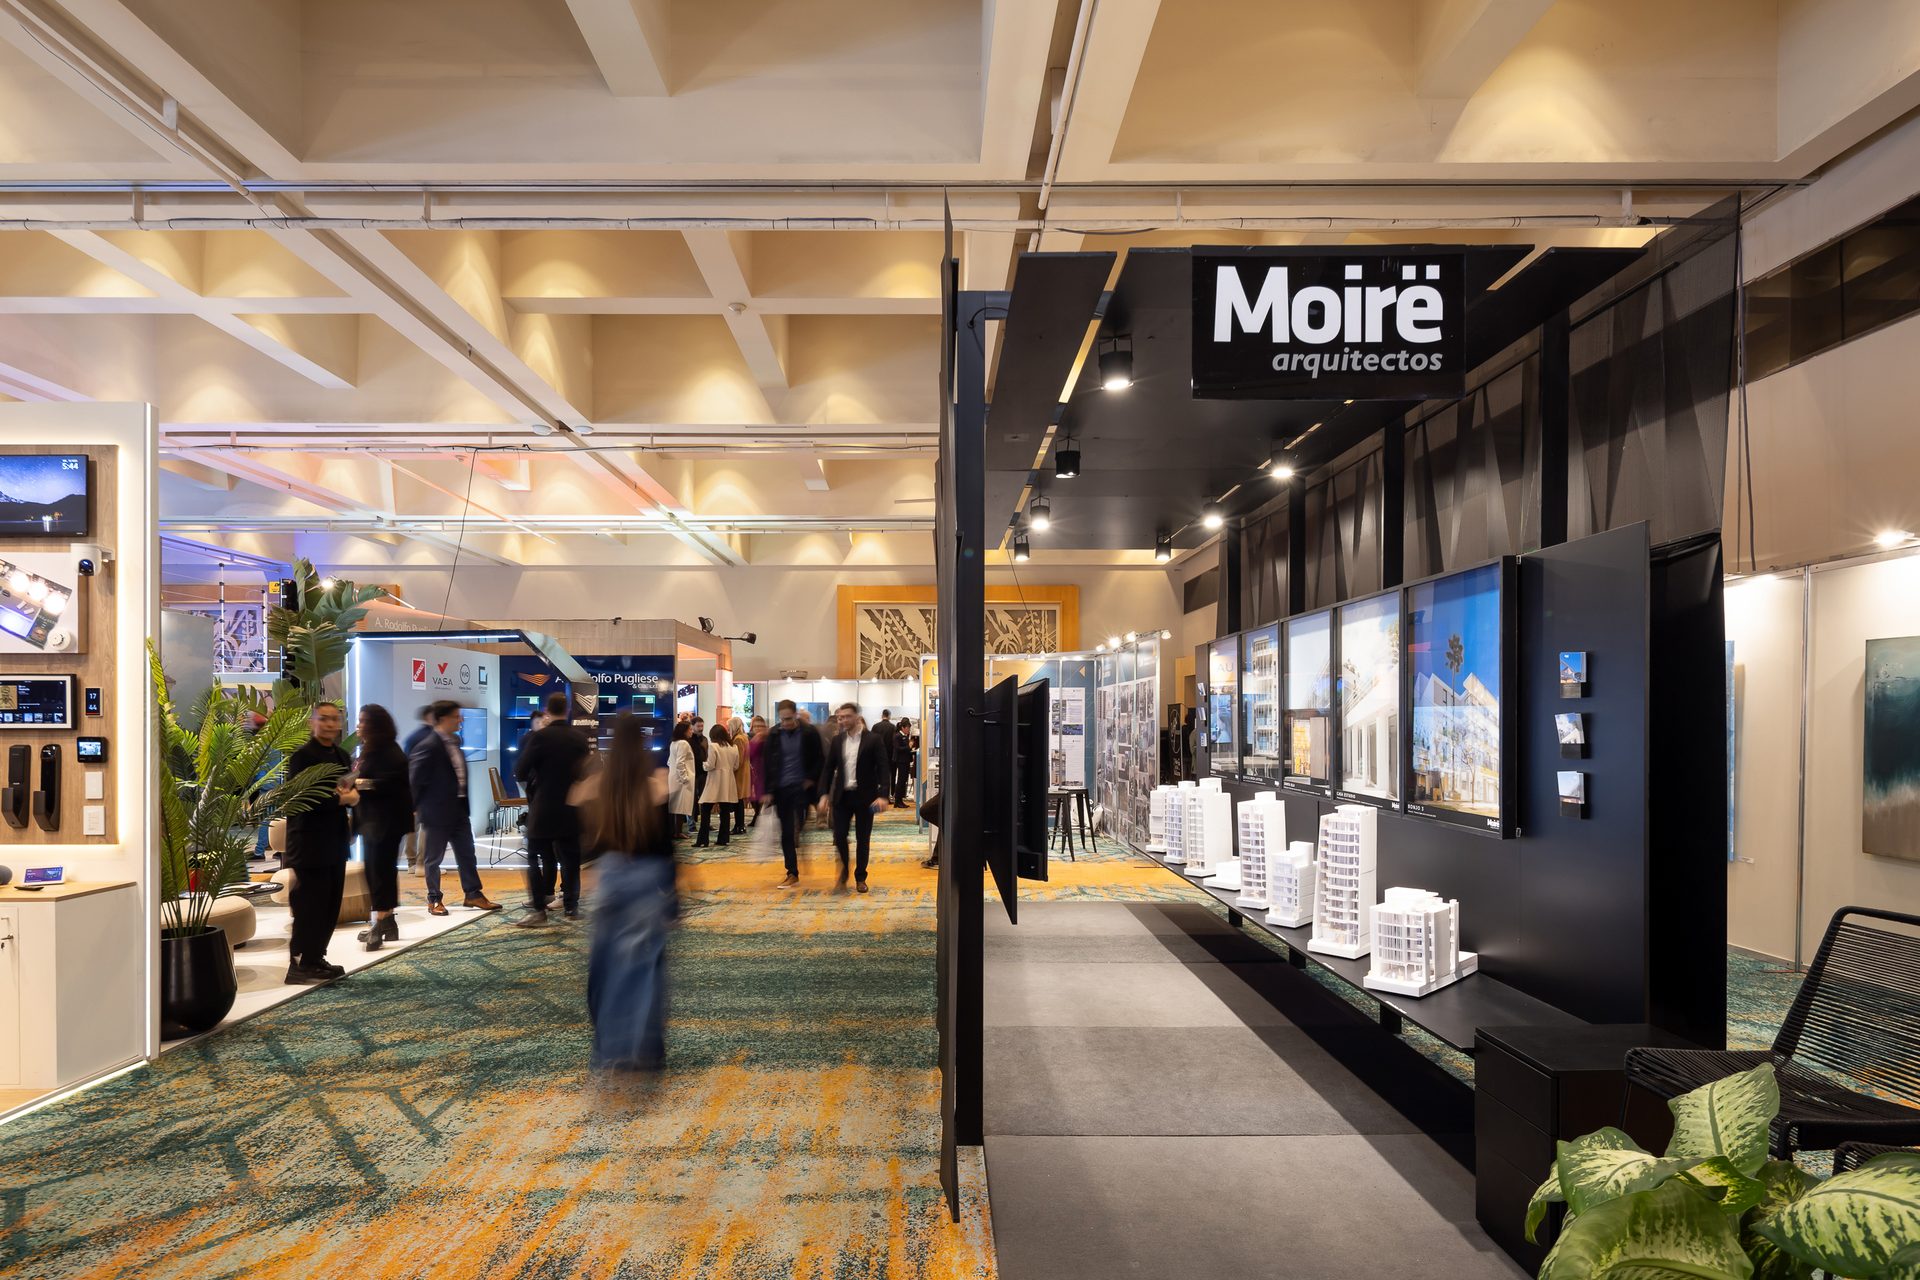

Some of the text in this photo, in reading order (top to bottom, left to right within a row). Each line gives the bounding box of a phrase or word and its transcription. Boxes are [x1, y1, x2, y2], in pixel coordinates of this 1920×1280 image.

[1214, 264, 1443, 344] Moirë
[1272, 347, 1443, 378] arquitectos
[432, 676, 454, 686] VASA
[614, 673, 659, 686] Pugliese
[89, 692, 97, 700] 17
